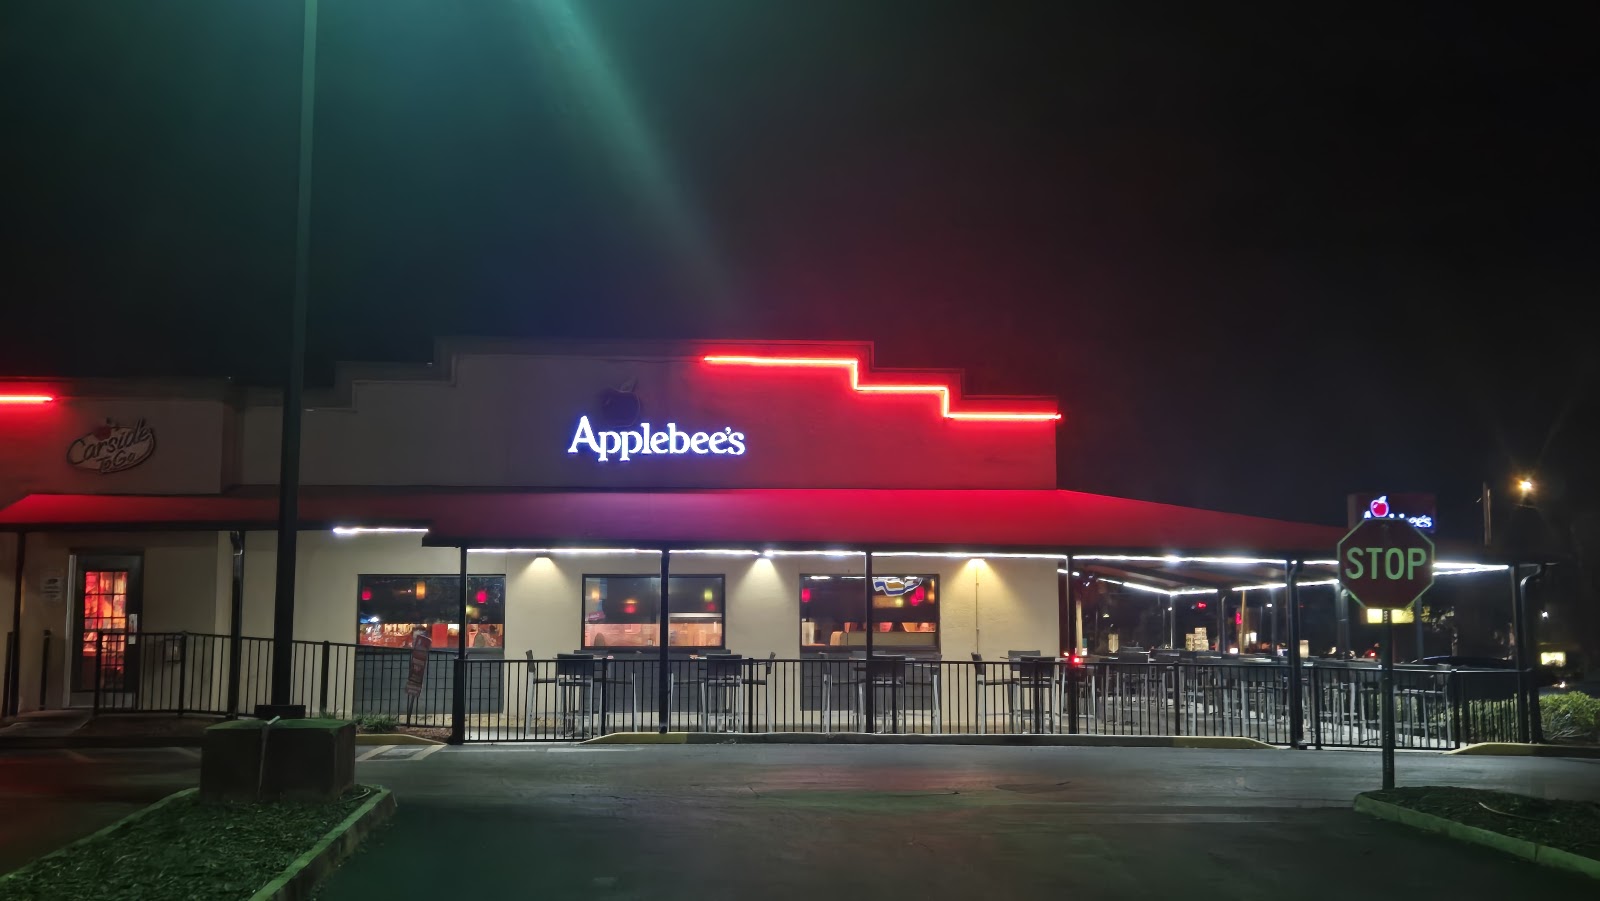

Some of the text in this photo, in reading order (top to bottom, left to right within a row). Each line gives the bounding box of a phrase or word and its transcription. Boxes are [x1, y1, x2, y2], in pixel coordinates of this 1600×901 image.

[66, 418, 152, 465] Carside
[568, 415, 746, 462] Applebee's
[96, 449, 136, 473] To Go
[1345, 547, 1427, 580] STOP
